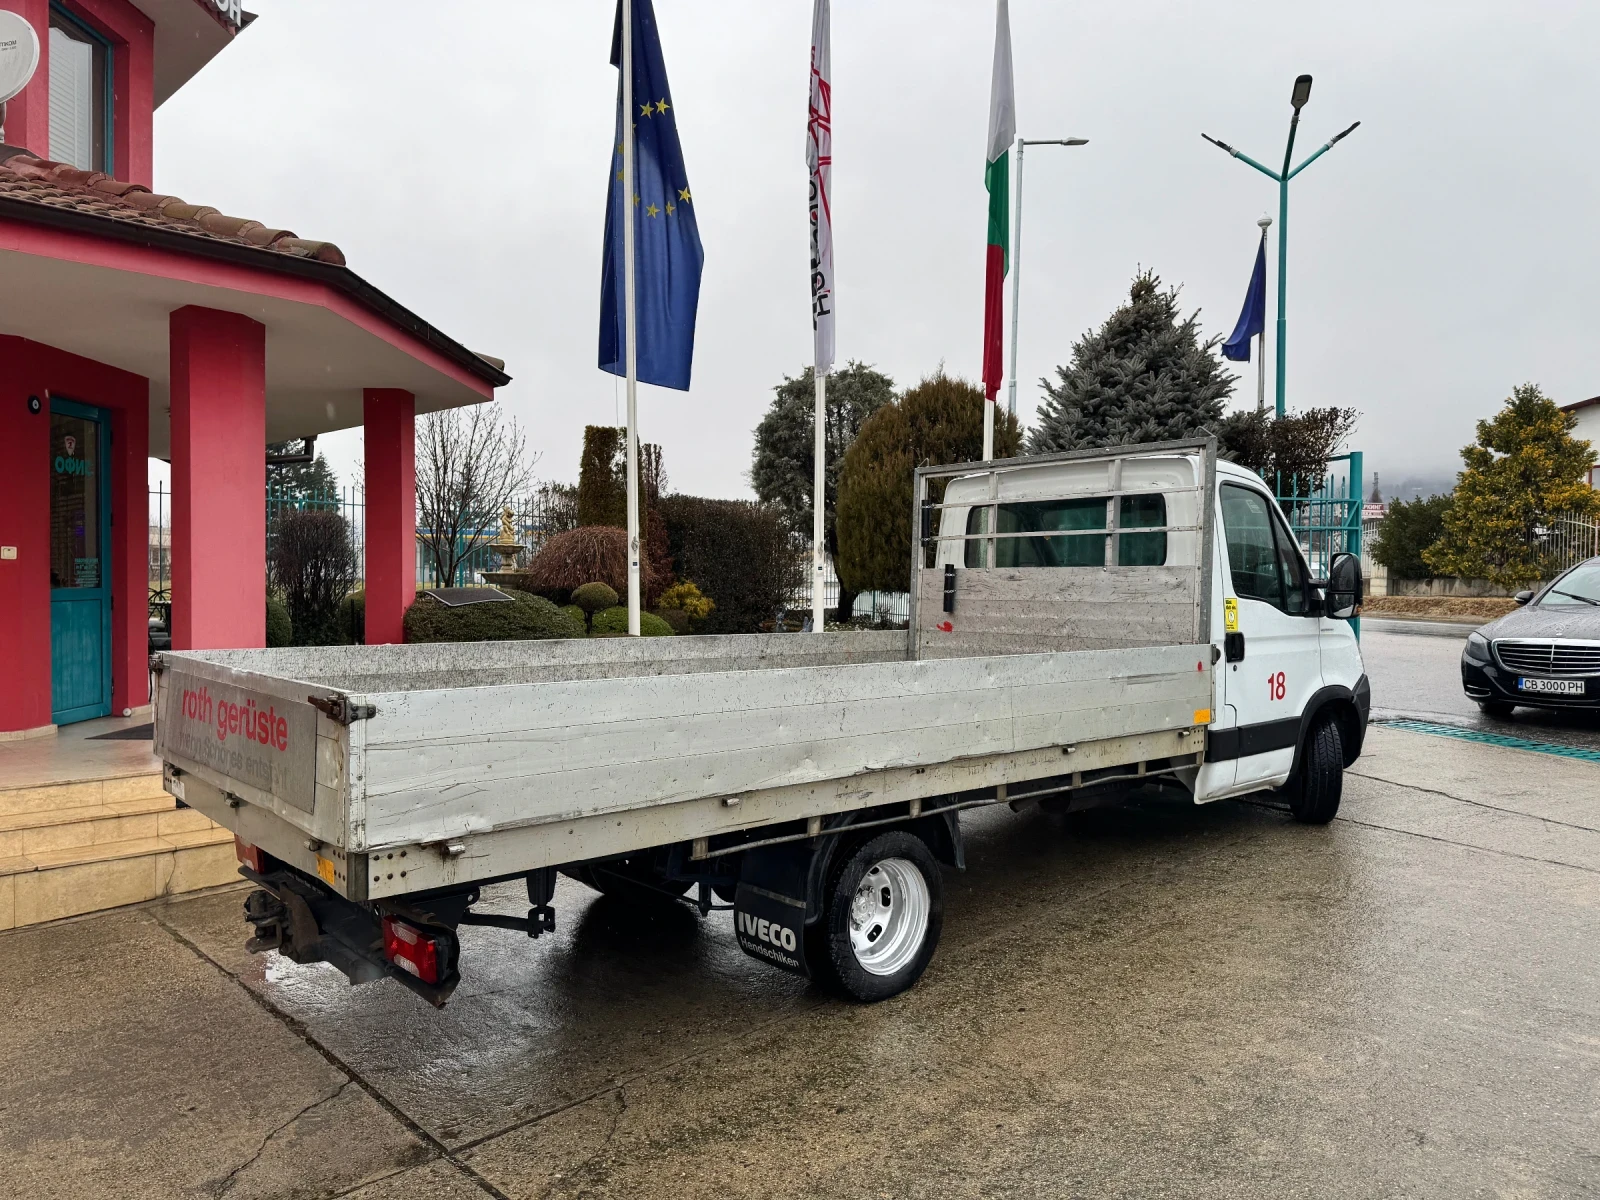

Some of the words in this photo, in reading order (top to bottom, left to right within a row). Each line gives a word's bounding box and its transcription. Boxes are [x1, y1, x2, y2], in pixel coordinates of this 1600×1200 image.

[1267, 671, 1286, 701] 18
[1524, 679, 1538, 690] CB
[1540, 680, 1566, 691] 3000
[1568, 681, 1583, 692] PH
[182, 686, 213, 724] roth
[216, 698, 288, 751] gerüste
[738, 911, 797, 952] IVECO
[740, 936, 800, 968] Hendschiken
